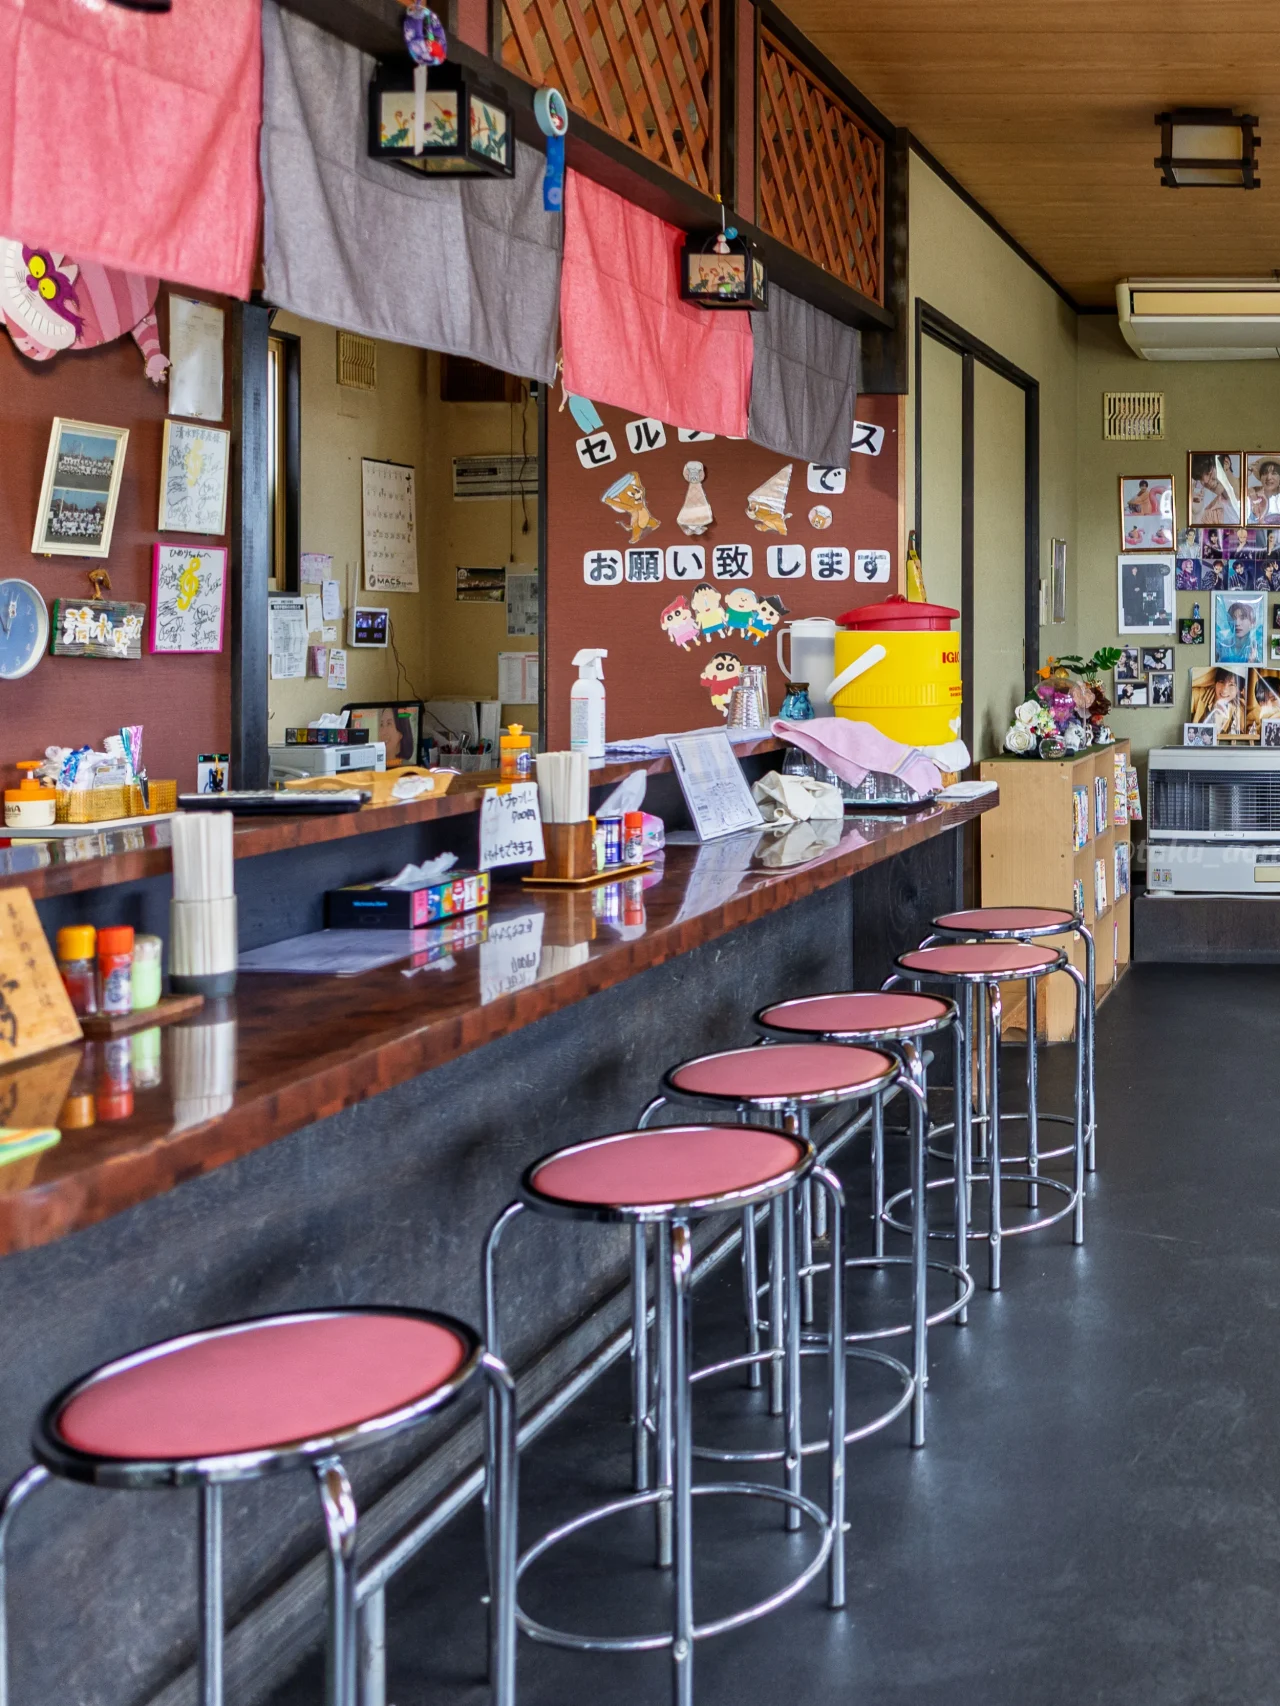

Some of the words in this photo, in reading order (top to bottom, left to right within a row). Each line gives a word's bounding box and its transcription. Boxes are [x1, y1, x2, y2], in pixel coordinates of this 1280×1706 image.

[590, 545, 887, 581] お願い致します
